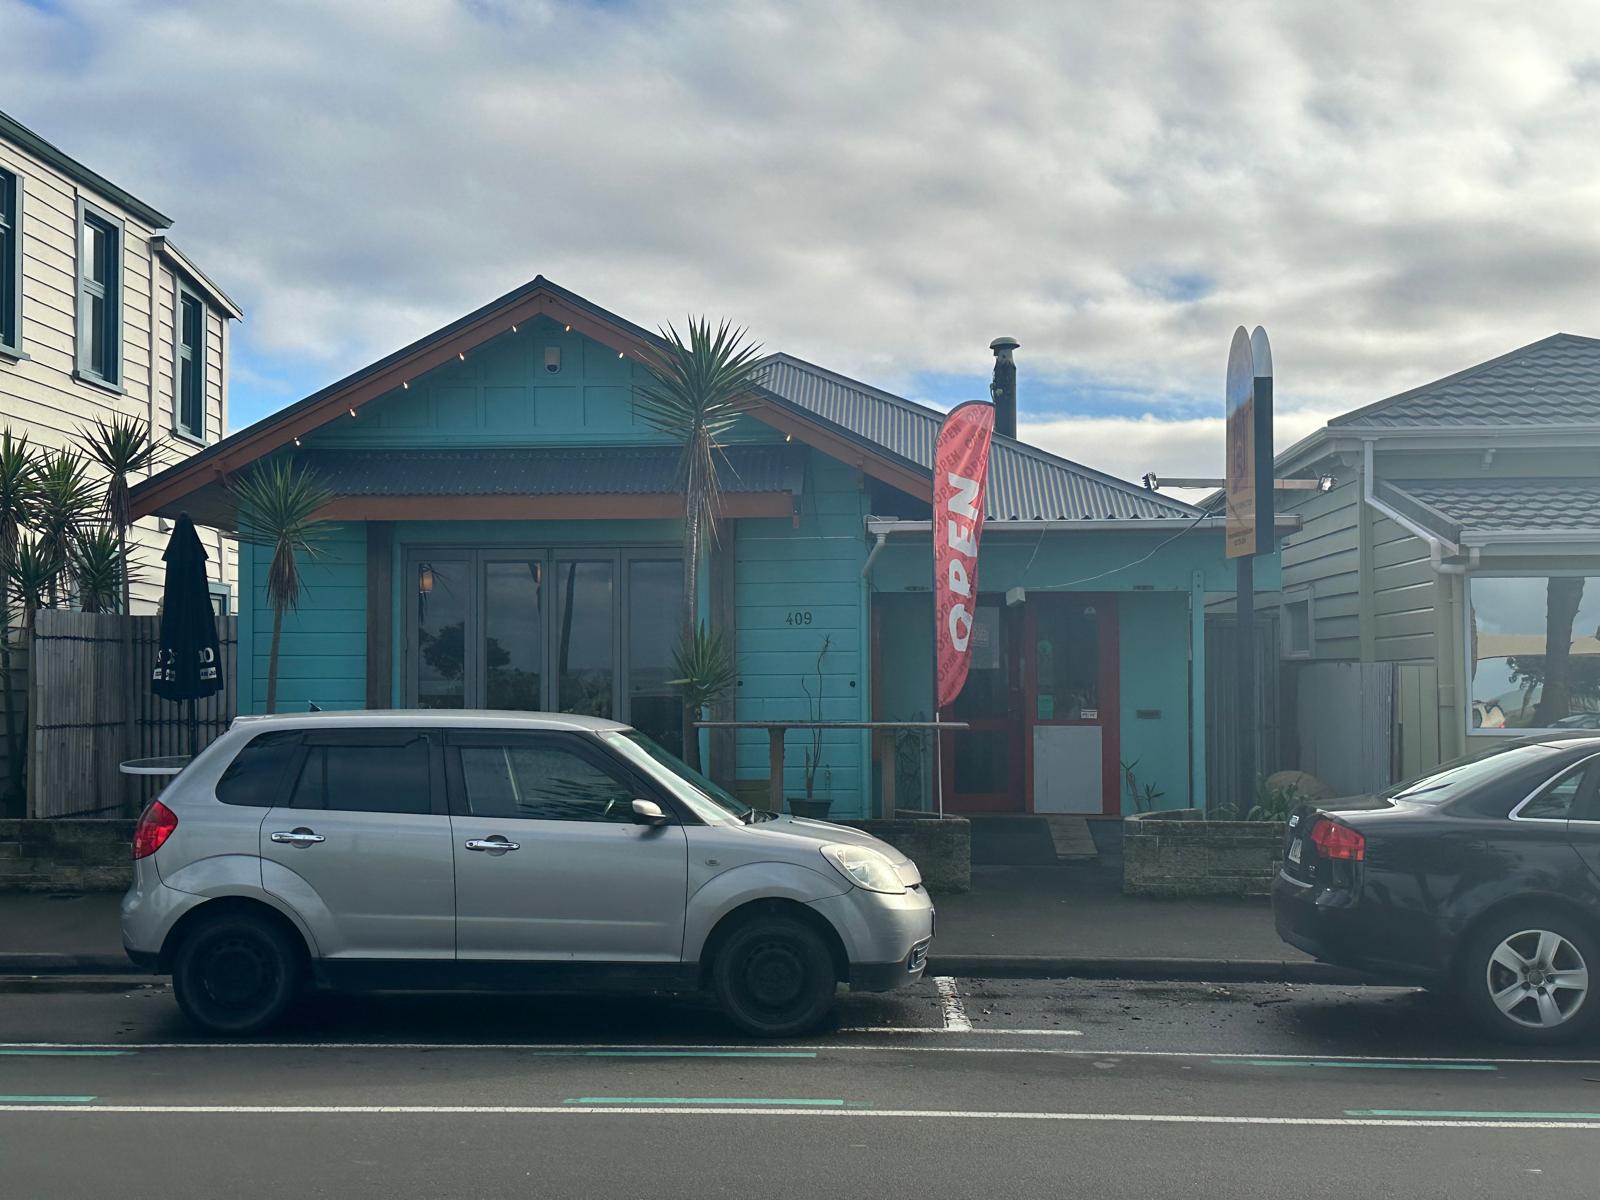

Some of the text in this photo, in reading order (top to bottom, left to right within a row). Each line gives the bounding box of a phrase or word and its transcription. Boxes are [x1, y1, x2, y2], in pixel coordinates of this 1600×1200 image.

[936, 450, 962, 476] OPEN
[948, 471, 979, 652] OPEN
[785, 611, 813, 626] 409
